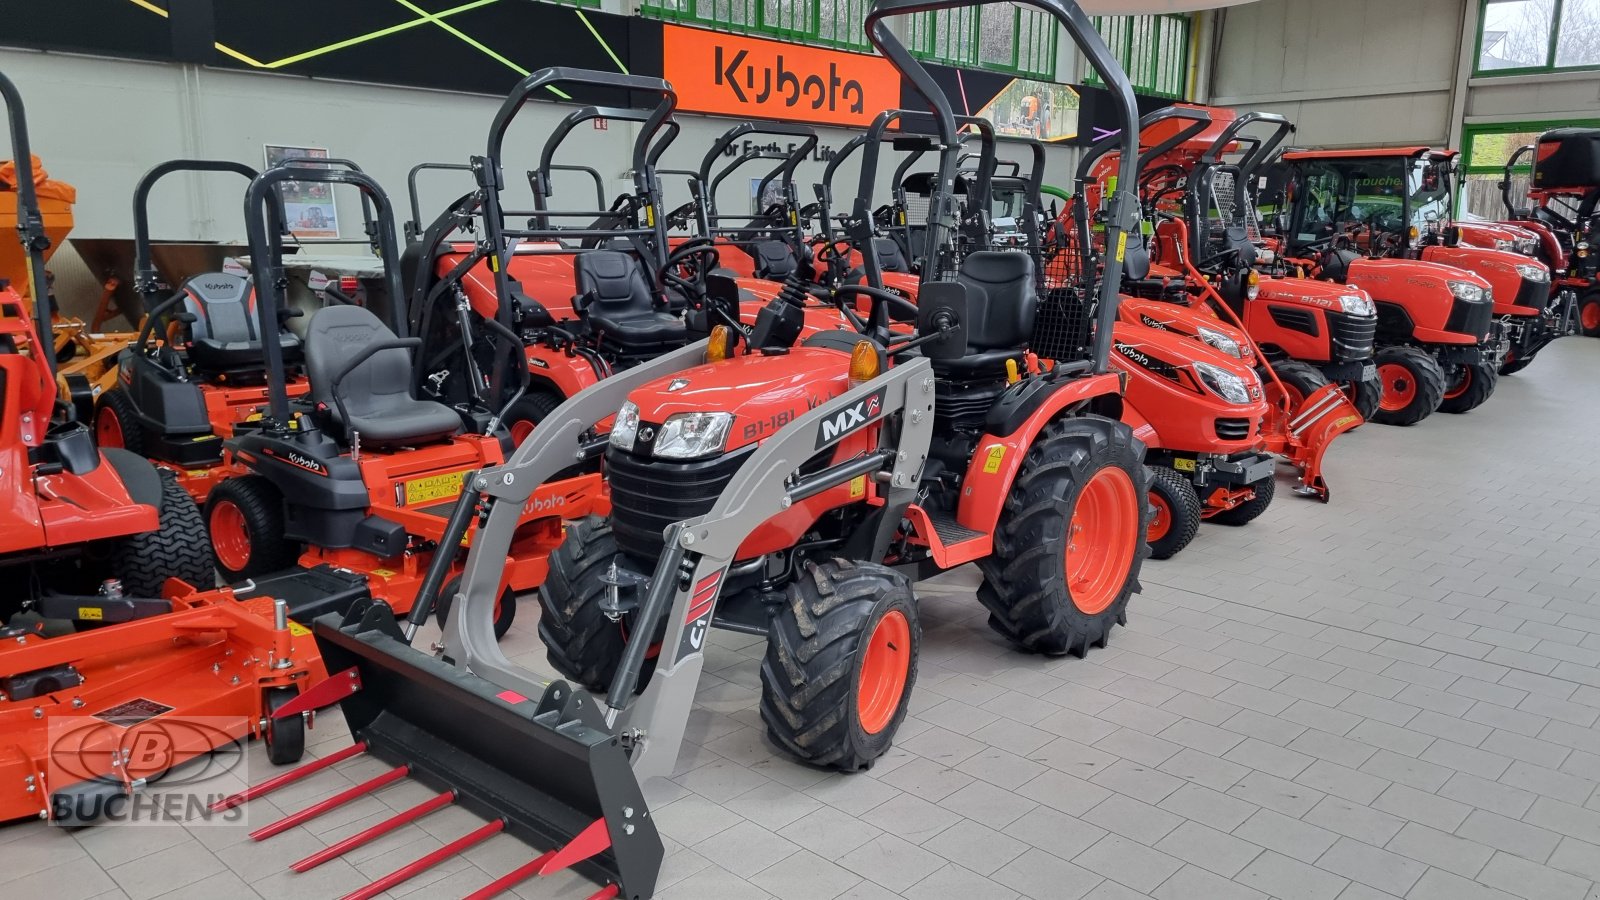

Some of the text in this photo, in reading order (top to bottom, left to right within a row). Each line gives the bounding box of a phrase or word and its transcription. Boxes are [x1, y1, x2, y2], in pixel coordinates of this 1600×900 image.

[714, 45, 864, 114] Kubota
[1301, 295, 1333, 308] B1-121
[1142, 315, 1168, 333] Kubota
[1117, 342, 1149, 366] Kubota
[743, 408, 796, 441] B1-181
[822, 400, 866, 442] MX
[288, 452, 320, 471] Kubota
[522, 493, 566, 515] ubota
